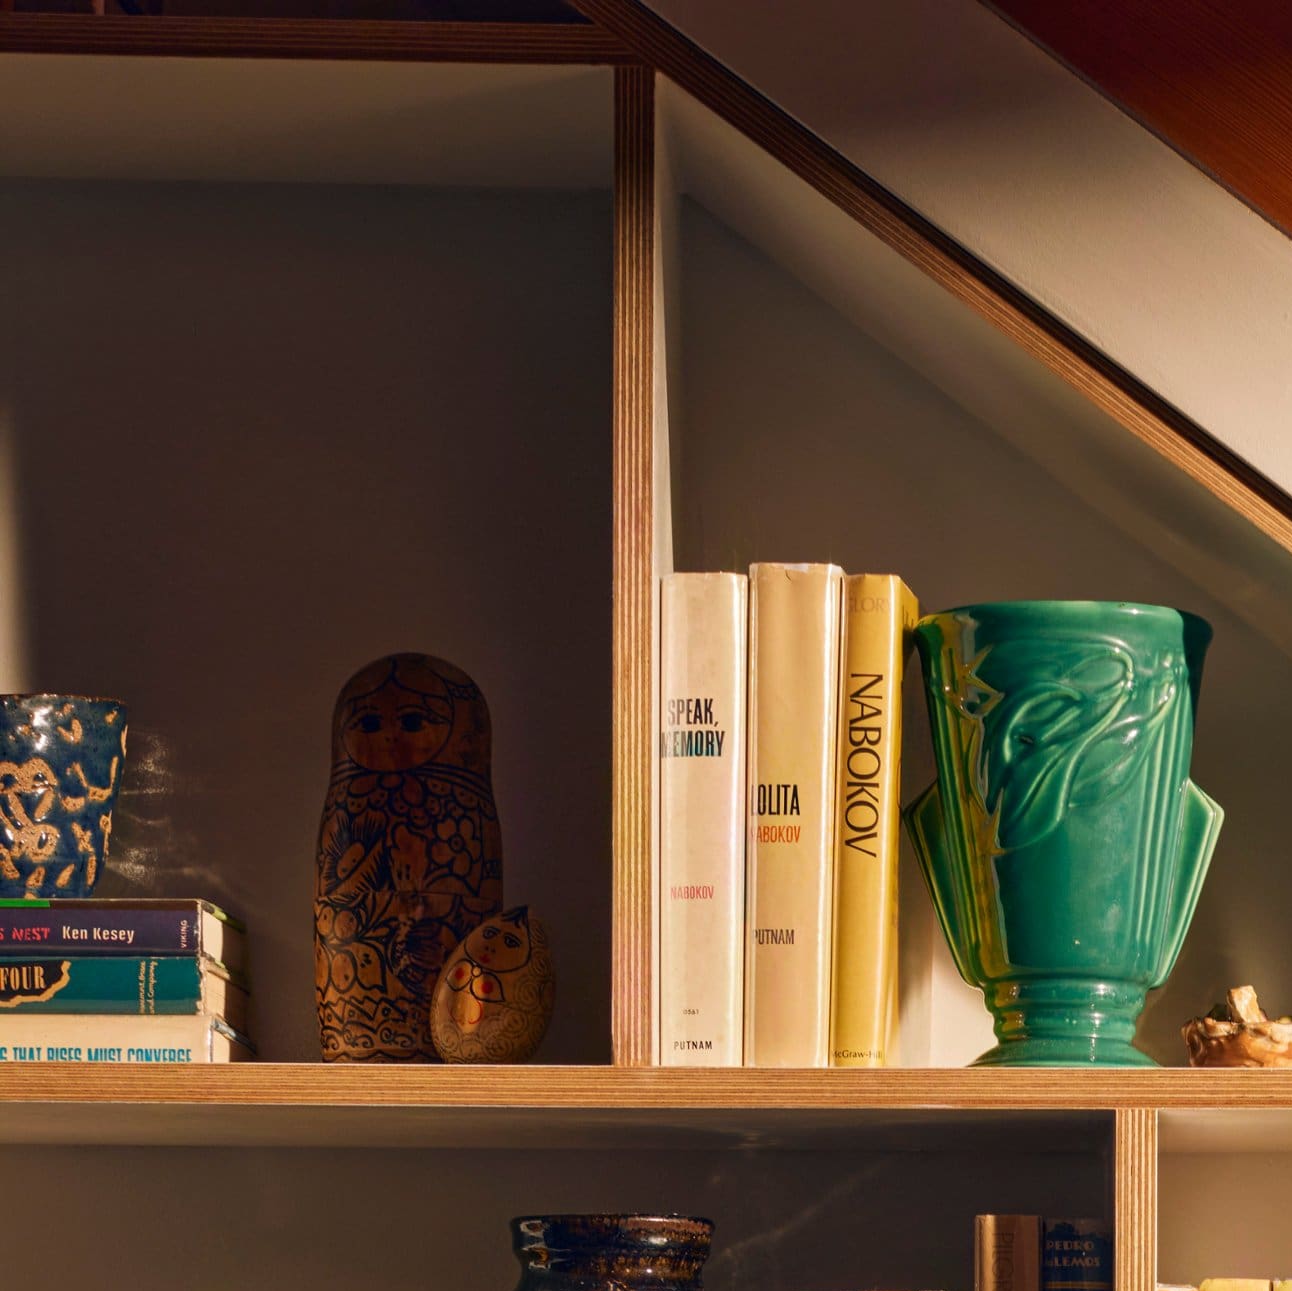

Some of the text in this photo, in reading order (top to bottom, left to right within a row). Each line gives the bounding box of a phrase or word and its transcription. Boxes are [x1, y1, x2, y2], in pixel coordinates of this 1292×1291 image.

[667, 698, 719, 727] SPEAK,
[661, 731, 725, 758] MEMORY
[844, 673, 883, 858] NABOKOV
[751, 784, 800, 816] LOLITA
[671, 885, 714, 899] NABOKOV
[12, 927, 50, 941] NEST
[62, 925, 88, 940] Ken
[93, 927, 134, 944] Kesey
[753, 929, 795, 945] PUTNAM
[0, 966, 45, 990] FOUR
[674, 1041, 713, 1050] PUTNAM
